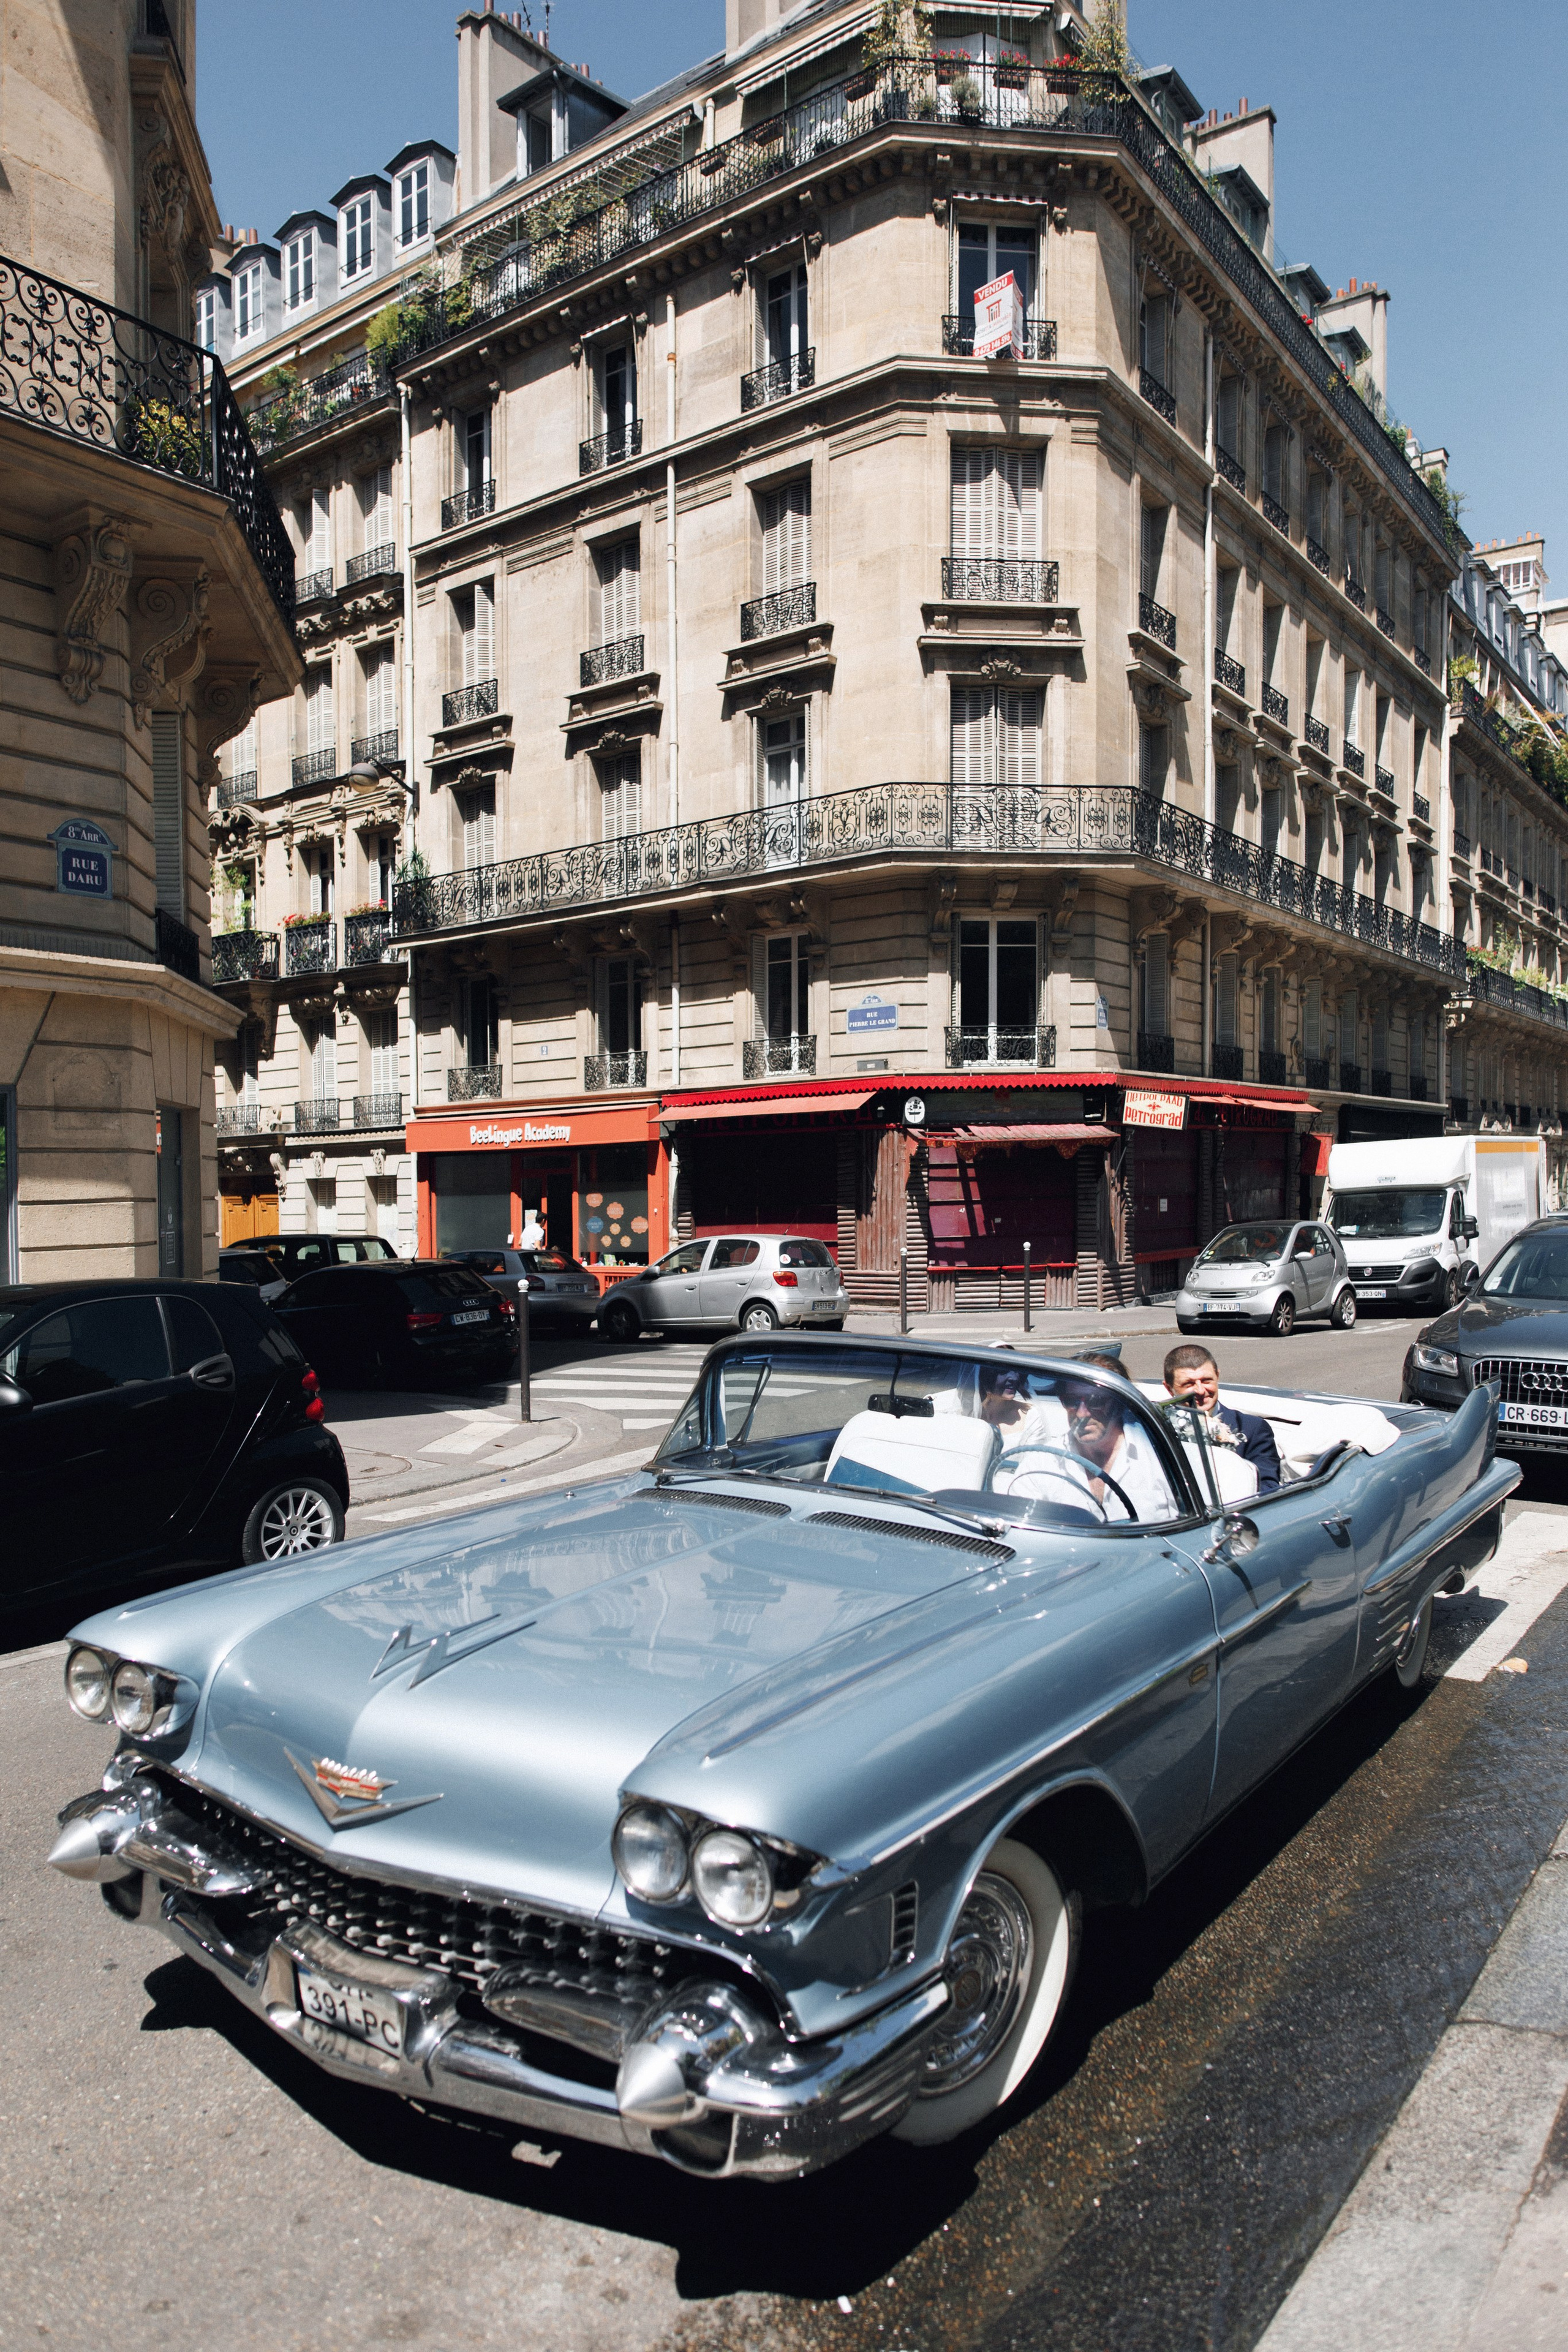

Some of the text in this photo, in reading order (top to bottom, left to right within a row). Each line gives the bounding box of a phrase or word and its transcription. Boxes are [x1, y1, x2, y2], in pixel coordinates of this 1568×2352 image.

[978, 277, 1008, 300] VENDU
[72, 858, 98, 871] RUE
[68, 872, 102, 886] DARU
[542, 1046, 547, 1055] 2
[1125, 1106, 1183, 1127] Petrograd
[470, 1122, 571, 1147] BeeLingue Academy
[307, 1986, 400, 2048] 391-PC
